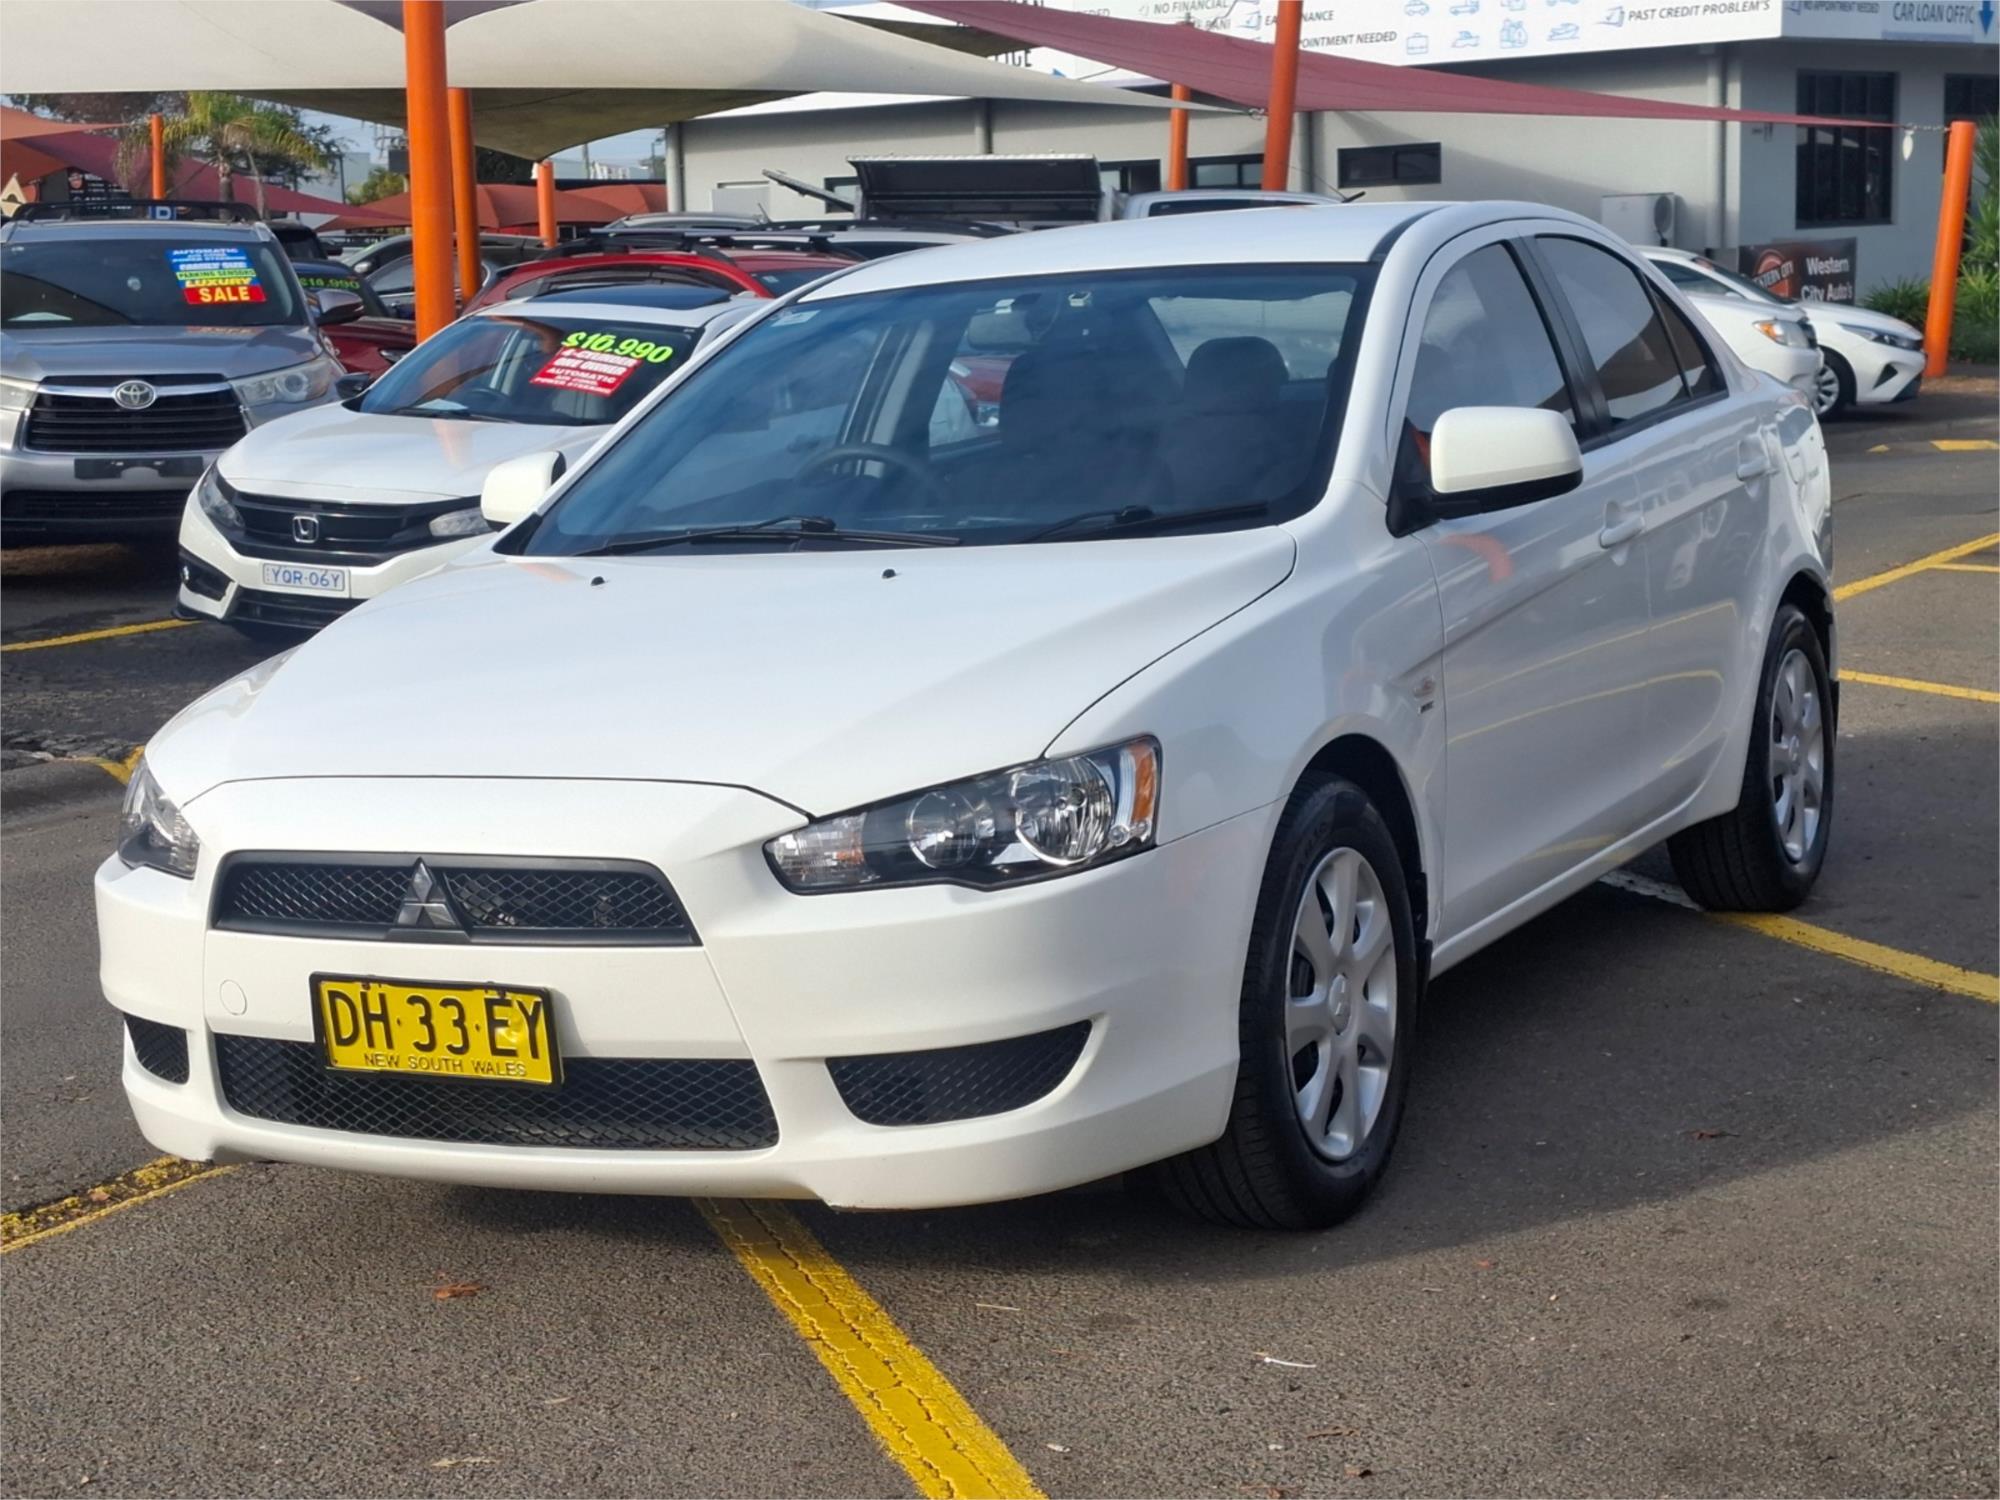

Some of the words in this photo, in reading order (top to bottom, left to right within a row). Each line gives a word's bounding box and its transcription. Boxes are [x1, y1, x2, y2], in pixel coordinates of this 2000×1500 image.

[1154, 4, 1169, 14] NO
[1172, 0, 1229, 13] FINANCIAL
[1628, 9, 1657, 21] PAST
[1659, 5, 1700, 19] CREDIT
[1702, 0, 1770, 16] PROBLEM'S
[1892, 2, 1914, 22] CAR
[1916, 3, 1944, 23] LOAN
[1301, 10, 1335, 22] NANCE
[1300, 34, 1355, 48] OINTMENT
[1356, 31, 1398, 44] NEEDED
[1805, 256, 1850, 276] Western
[185, 276, 252, 288] LUXURY
[198, 286, 251, 303] SALE
[1801, 284, 1825, 302] City
[546, 367, 617, 384] AUTOMATIC
[364, 1053, 400, 1069] NEW
[407, 1055, 464, 1074] SOUTH
[471, 1059, 527, 1077] WALES
